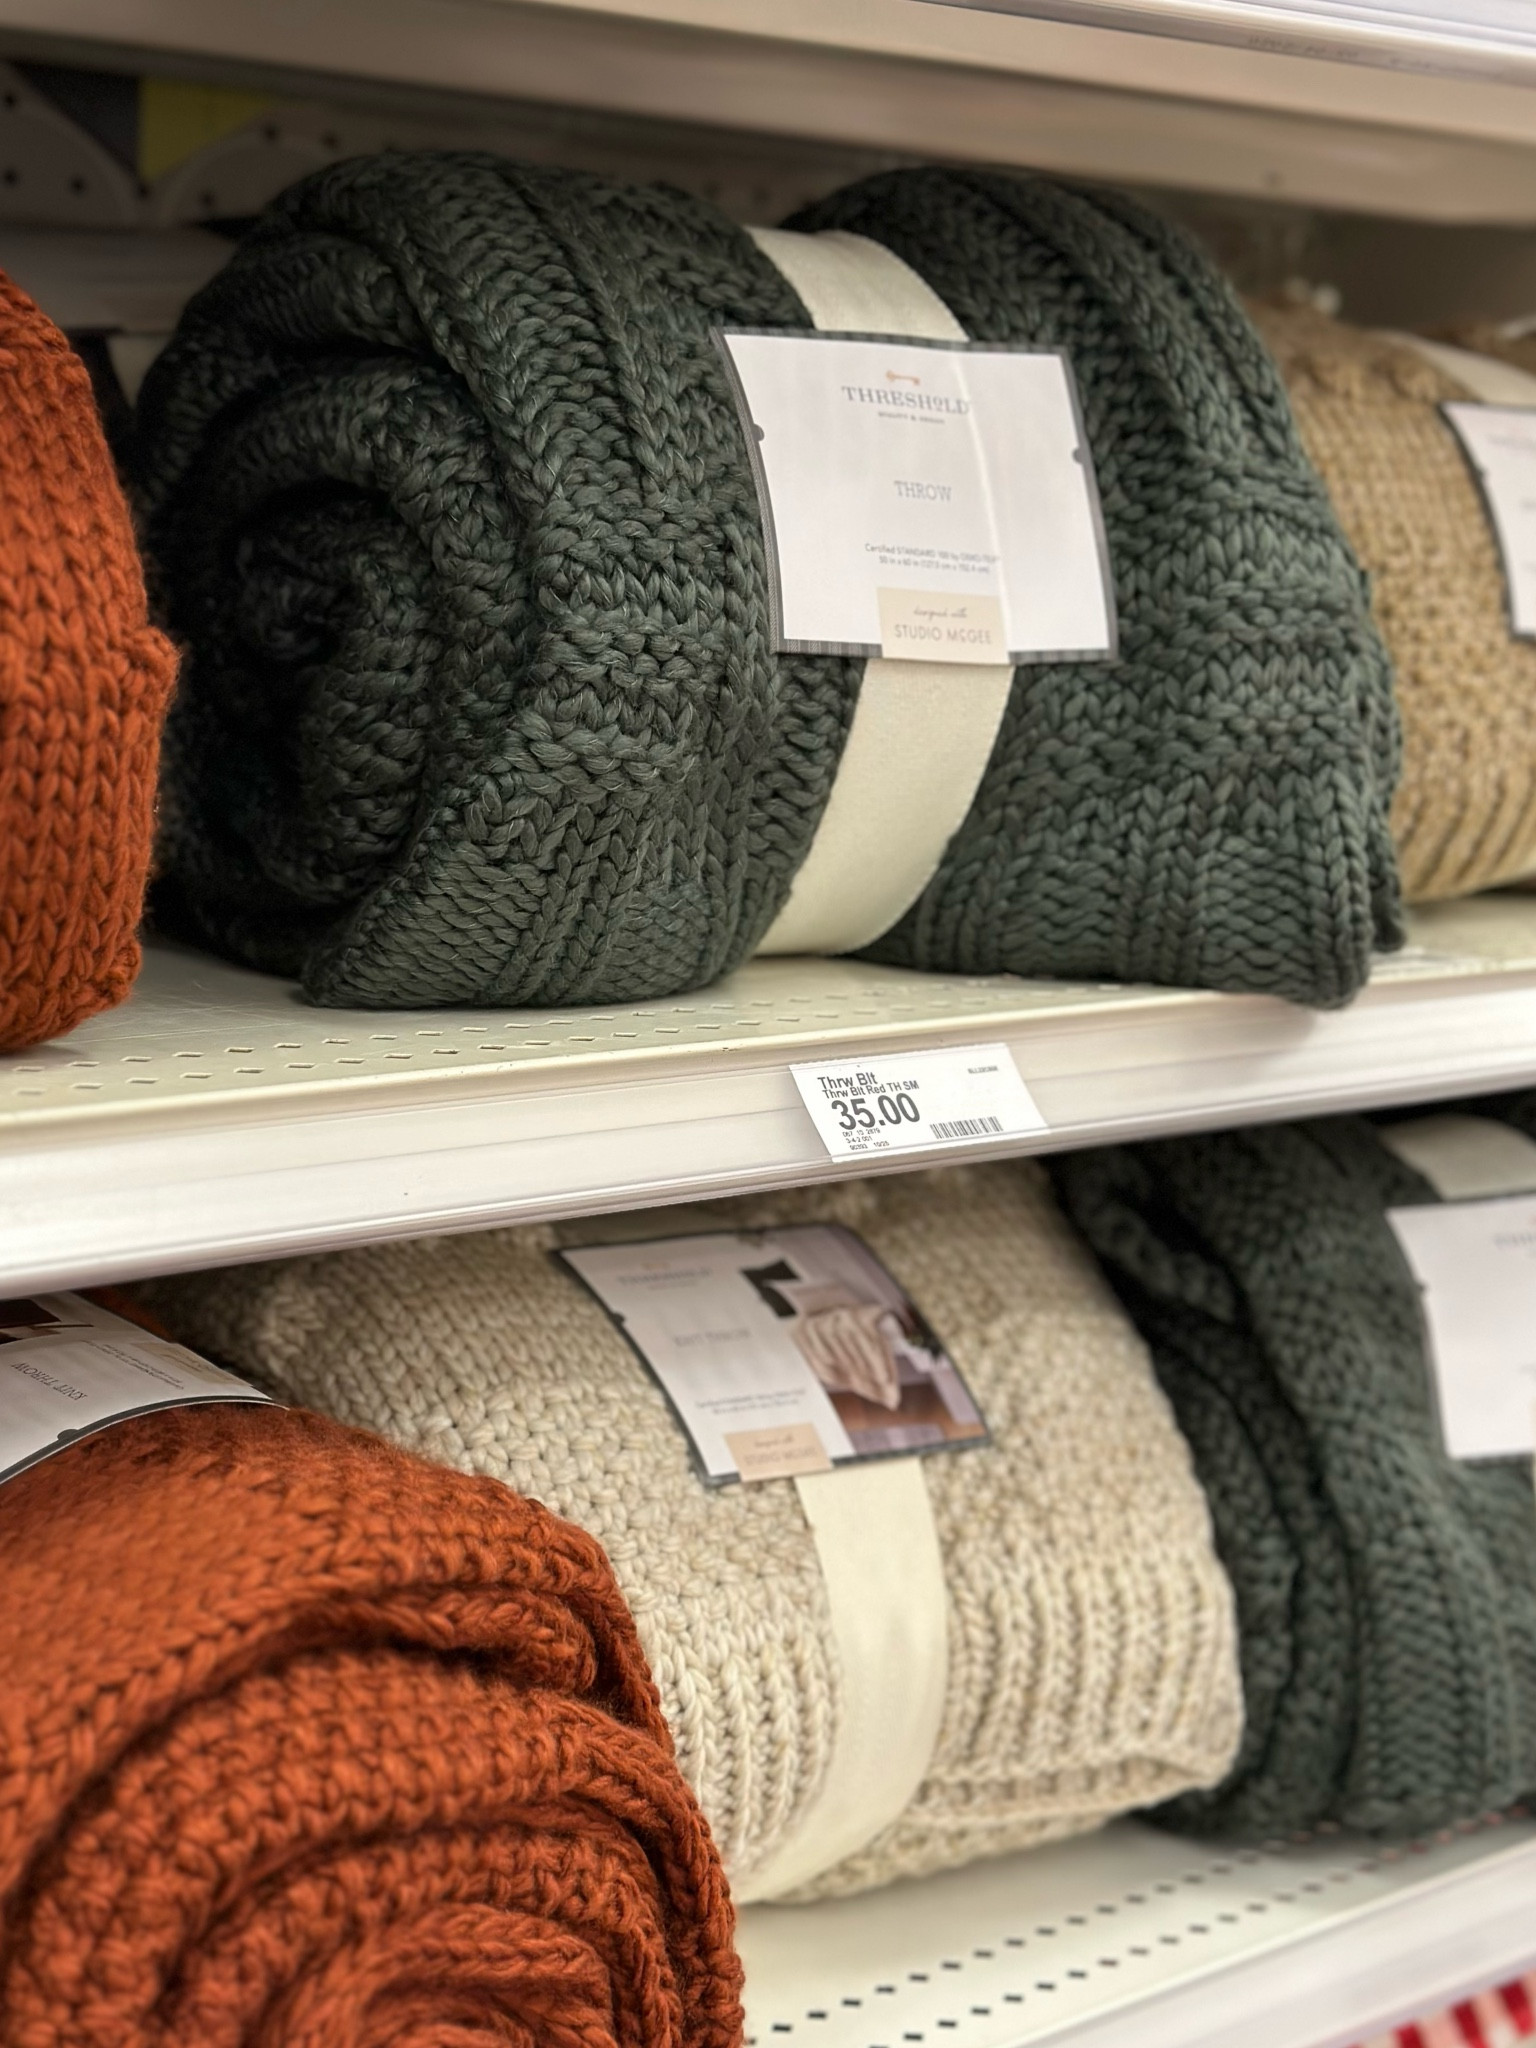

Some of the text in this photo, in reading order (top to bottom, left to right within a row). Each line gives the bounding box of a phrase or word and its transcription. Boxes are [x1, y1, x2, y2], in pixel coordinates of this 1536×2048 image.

[841, 385, 969, 415] THRESHOLD
[893, 480, 952, 501] THROW
[864, 543, 895, 554] Certified
[894, 624, 942, 641] STUDIO
[817, 1072, 878, 1090] Thrw Blt
[822, 1080, 920, 1099] Thrw Blt Red TH SM
[831, 1093, 920, 1130] 35.00
[11, 1363, 88, 1401] KNIT THROW
